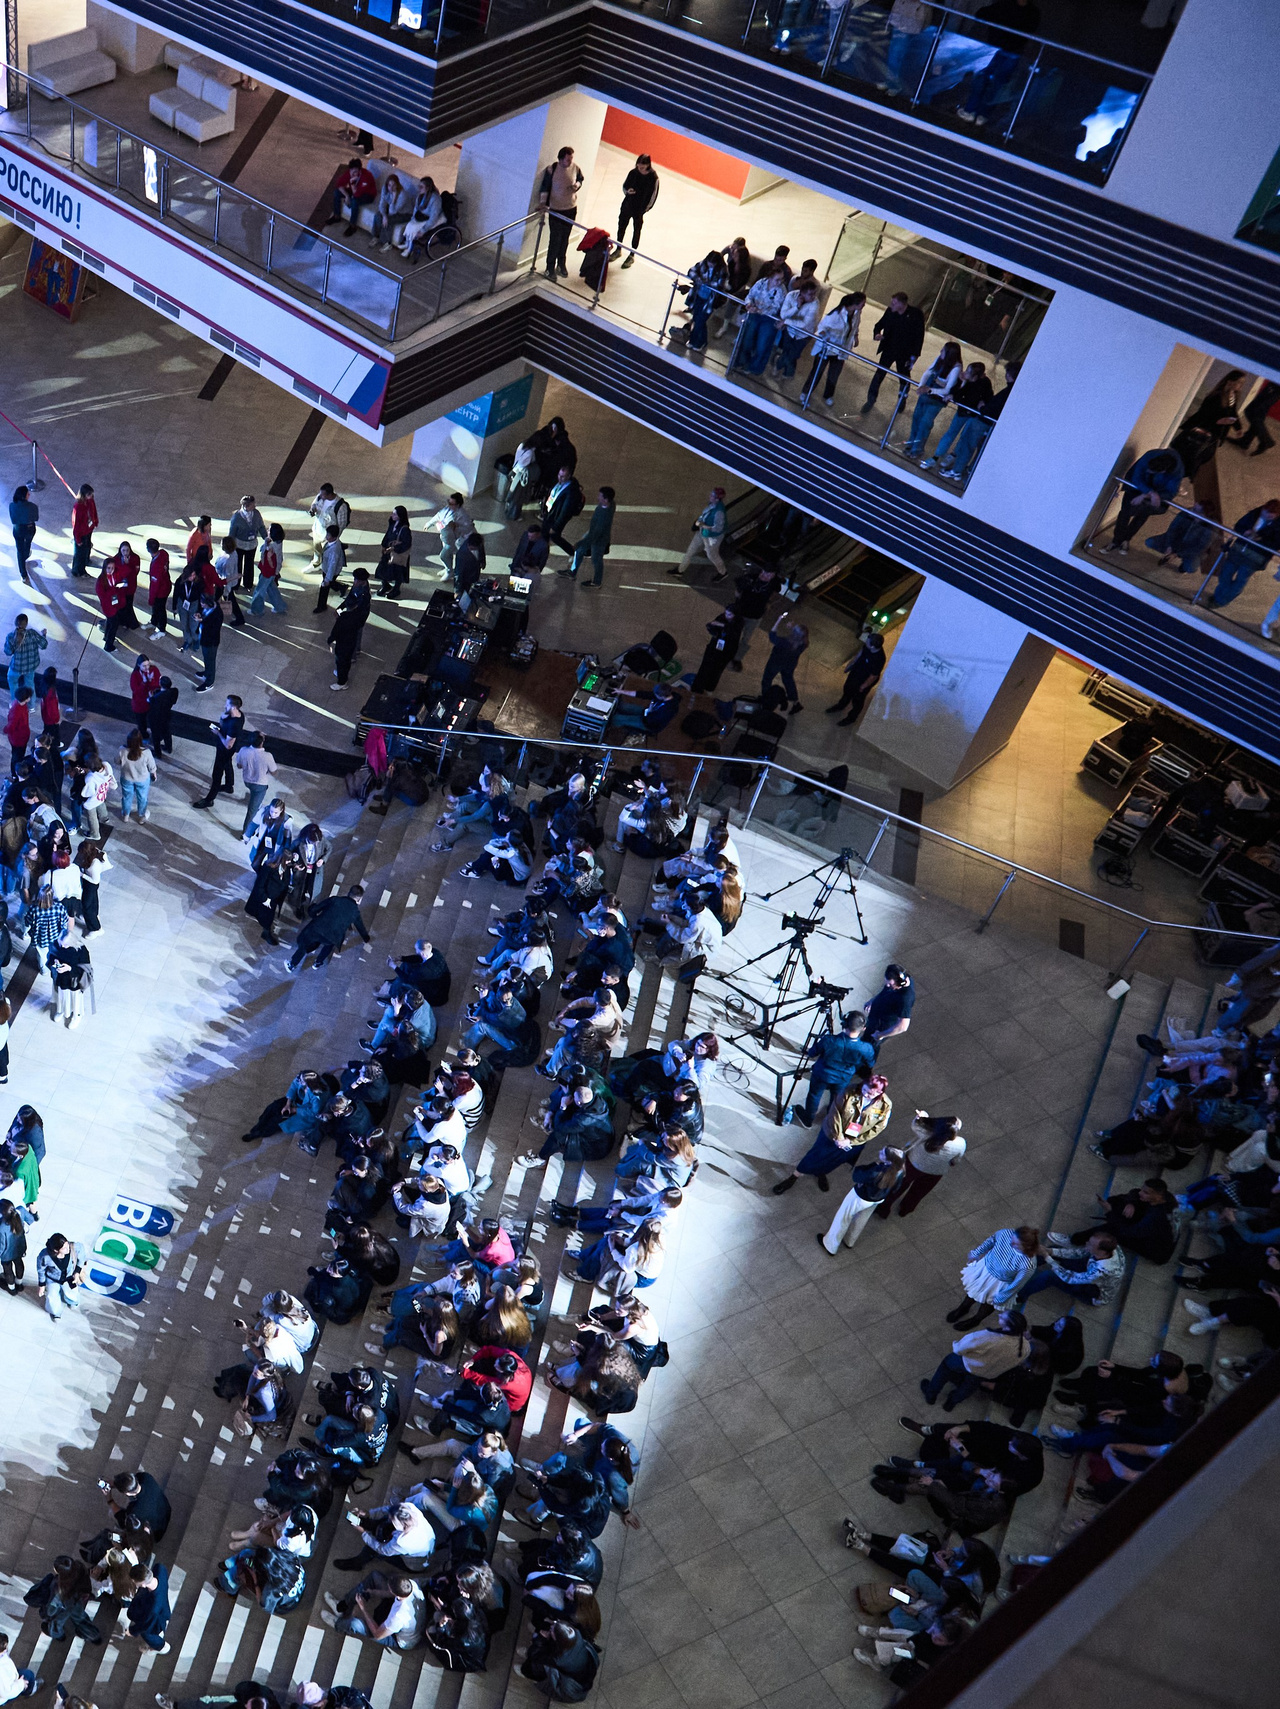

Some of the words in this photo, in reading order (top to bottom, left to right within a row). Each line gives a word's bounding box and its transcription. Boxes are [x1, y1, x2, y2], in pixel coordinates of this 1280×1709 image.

[109, 1198, 153, 1228] B
[94, 1231, 136, 1263] C
[83, 1260, 126, 1295] D
